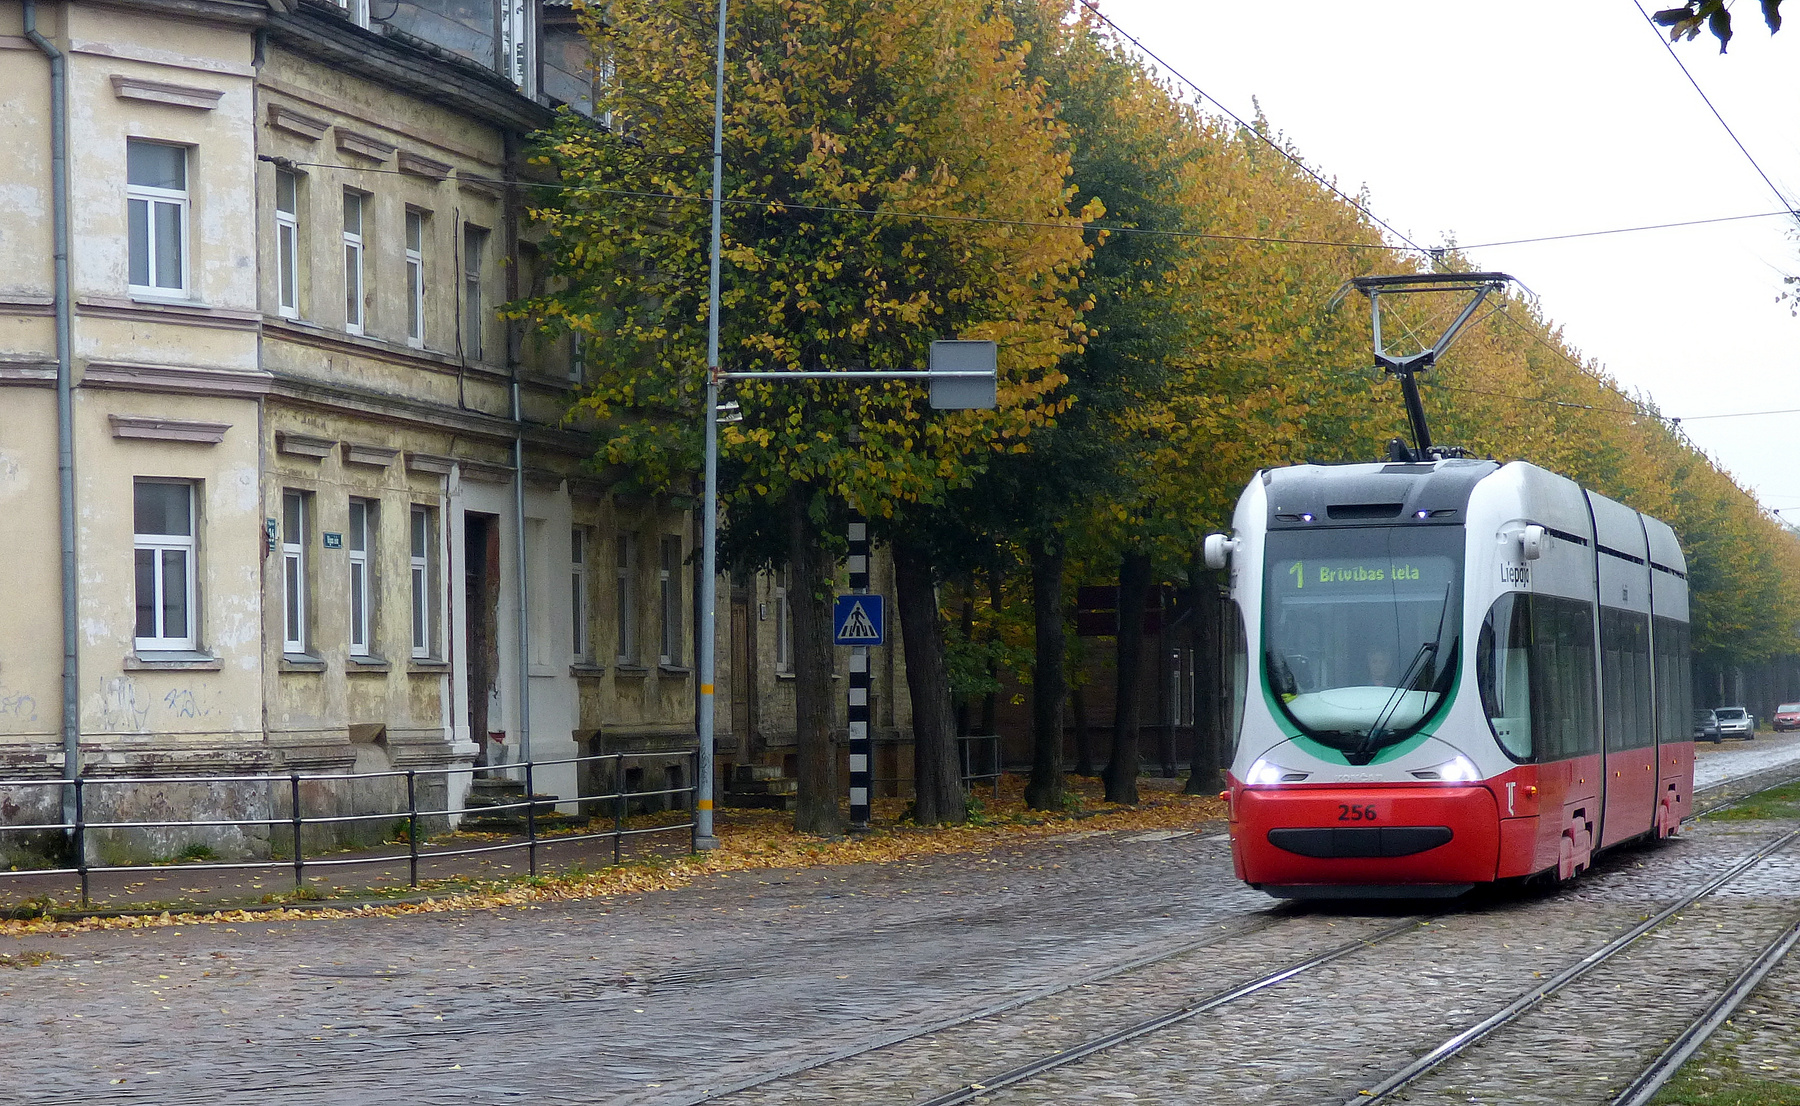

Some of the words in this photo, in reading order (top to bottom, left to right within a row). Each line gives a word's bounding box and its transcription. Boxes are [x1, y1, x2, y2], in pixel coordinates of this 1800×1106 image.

[1289, 560, 1304, 589] 1
[1320, 566, 1385, 582] Brīvības
[1391, 564, 1420, 580] iela
[1338, 804, 1377, 821] 256
